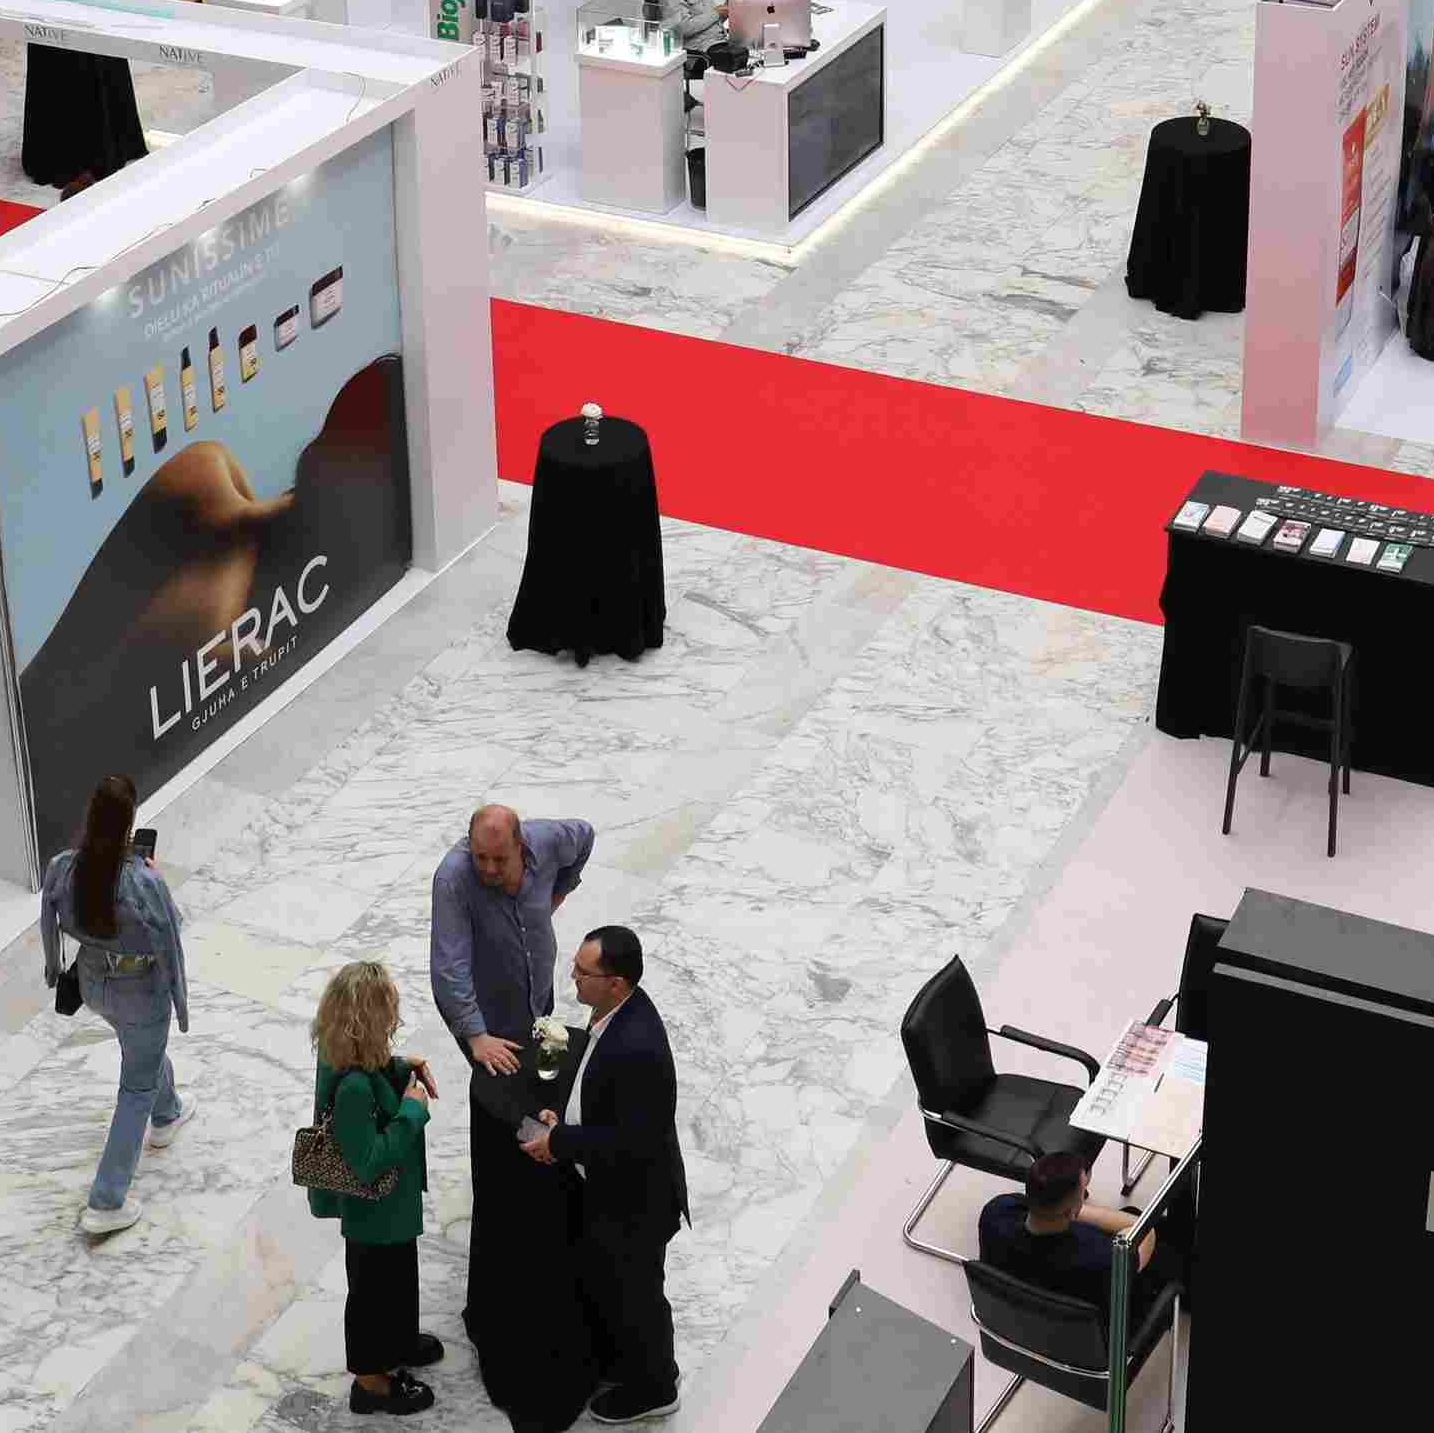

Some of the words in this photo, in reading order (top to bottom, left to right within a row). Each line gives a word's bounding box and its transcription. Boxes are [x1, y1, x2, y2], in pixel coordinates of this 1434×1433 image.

[23, 23, 66, 43] NATIVE
[158, 44, 204, 65] NATIVE
[128, 198, 291, 317] SUNISSIME
[149, 555, 330, 740] LIERAC
[191, 687, 236, 731] GJUHA
